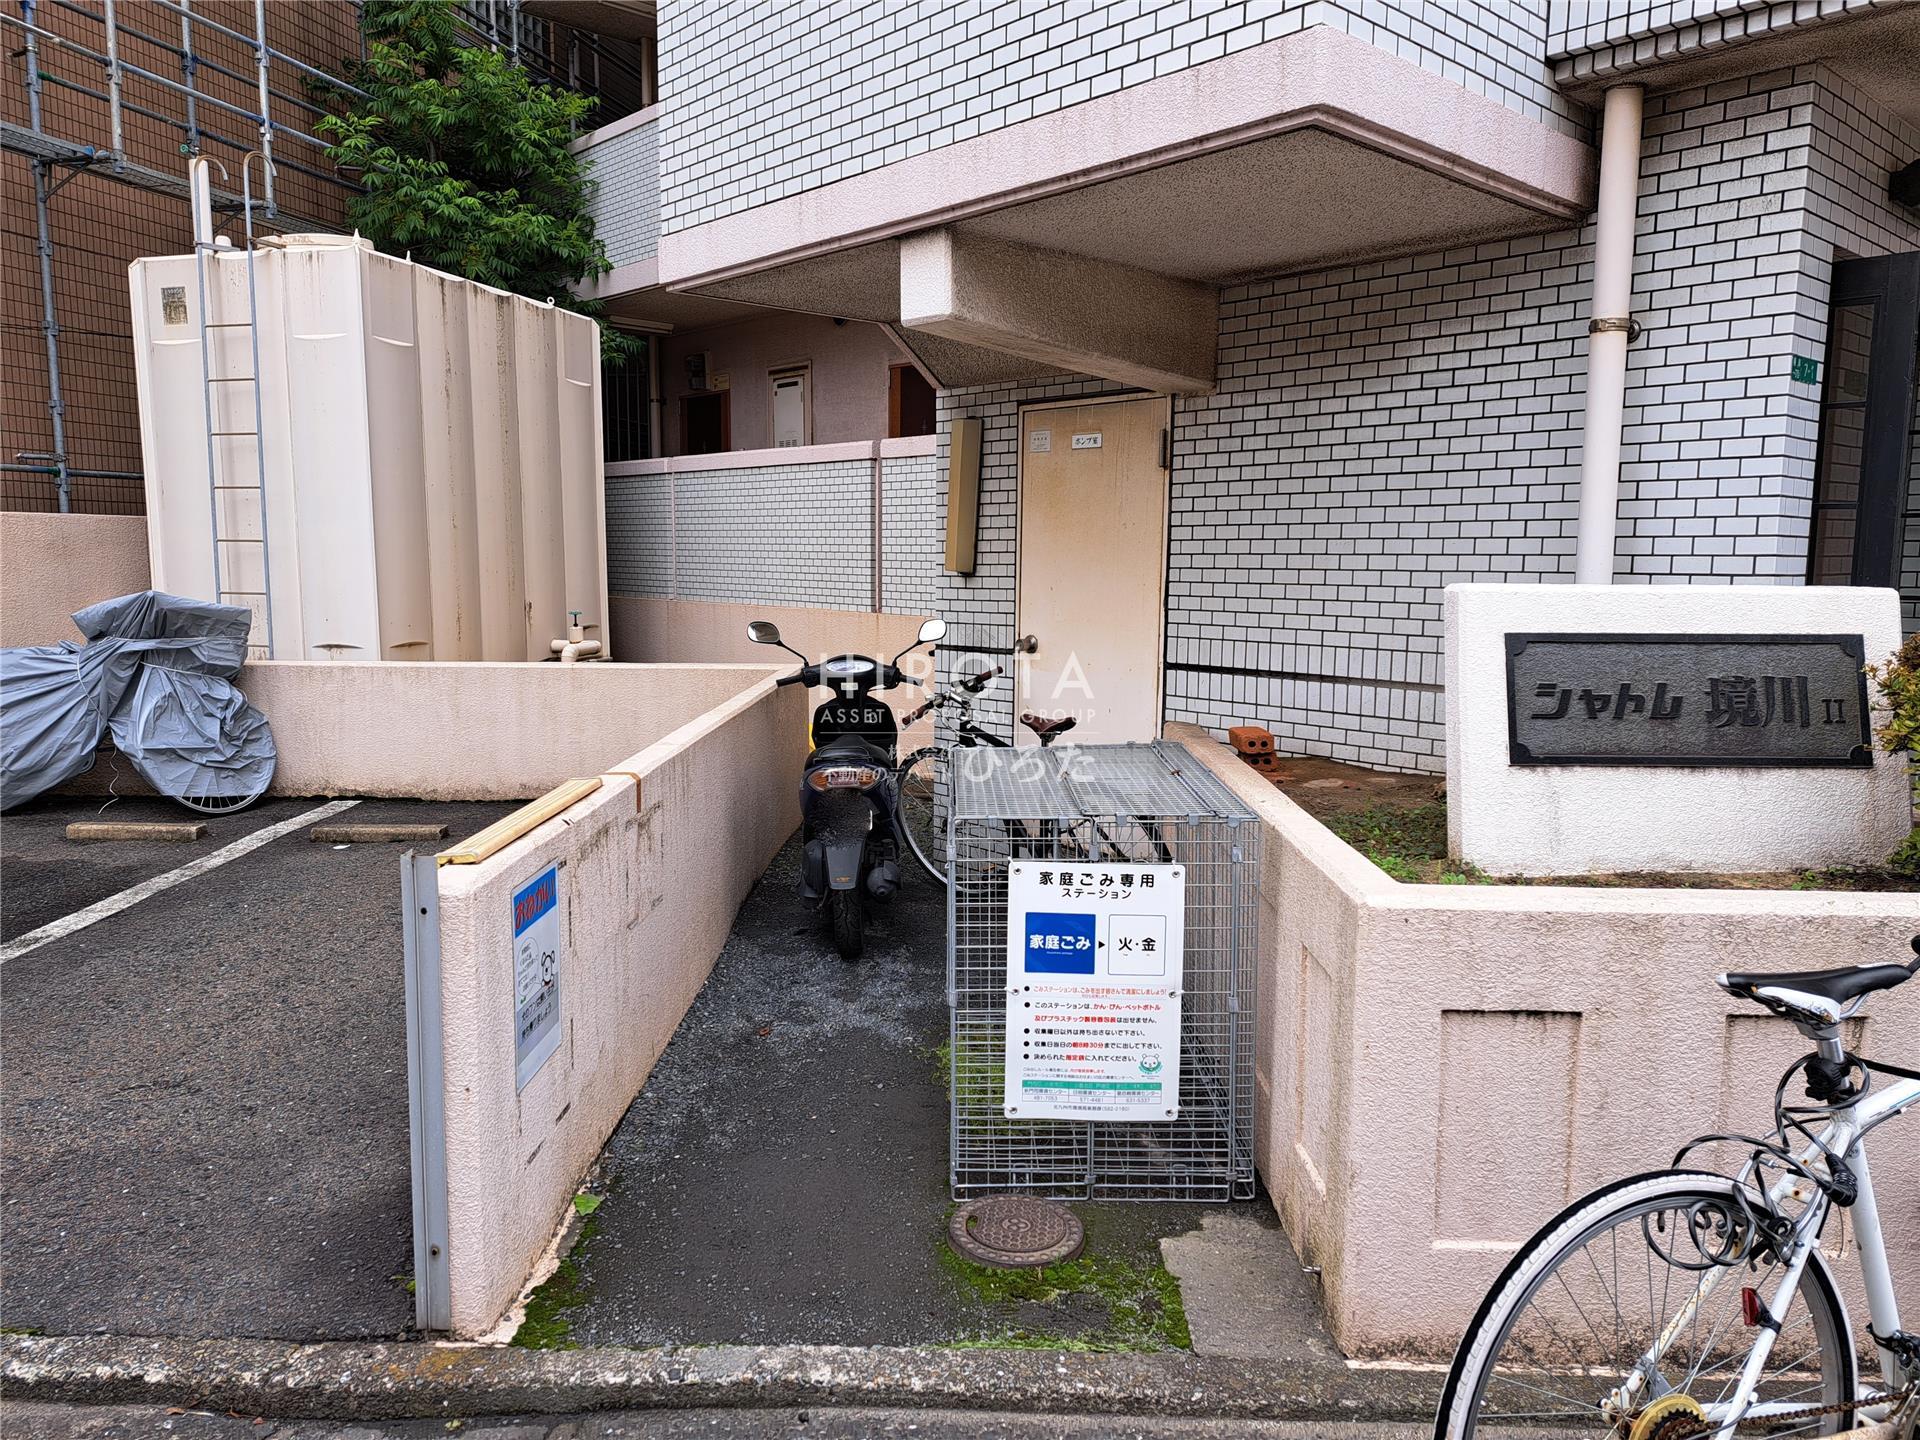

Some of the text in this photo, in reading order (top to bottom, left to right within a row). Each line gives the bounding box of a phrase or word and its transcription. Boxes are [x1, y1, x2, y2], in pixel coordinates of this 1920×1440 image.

[1531, 682, 1684, 719] シャトム
[1706, 675, 1810, 728] 境川
[1039, 871, 1155, 888] 家庭ごみ専用
[1061, 888, 1132, 899] ステーション
[515, 876, 556, 931] おねがい
[1029, 934, 1091, 950] 家庭ごみ
[1118, 937, 1156, 952] 火・金
